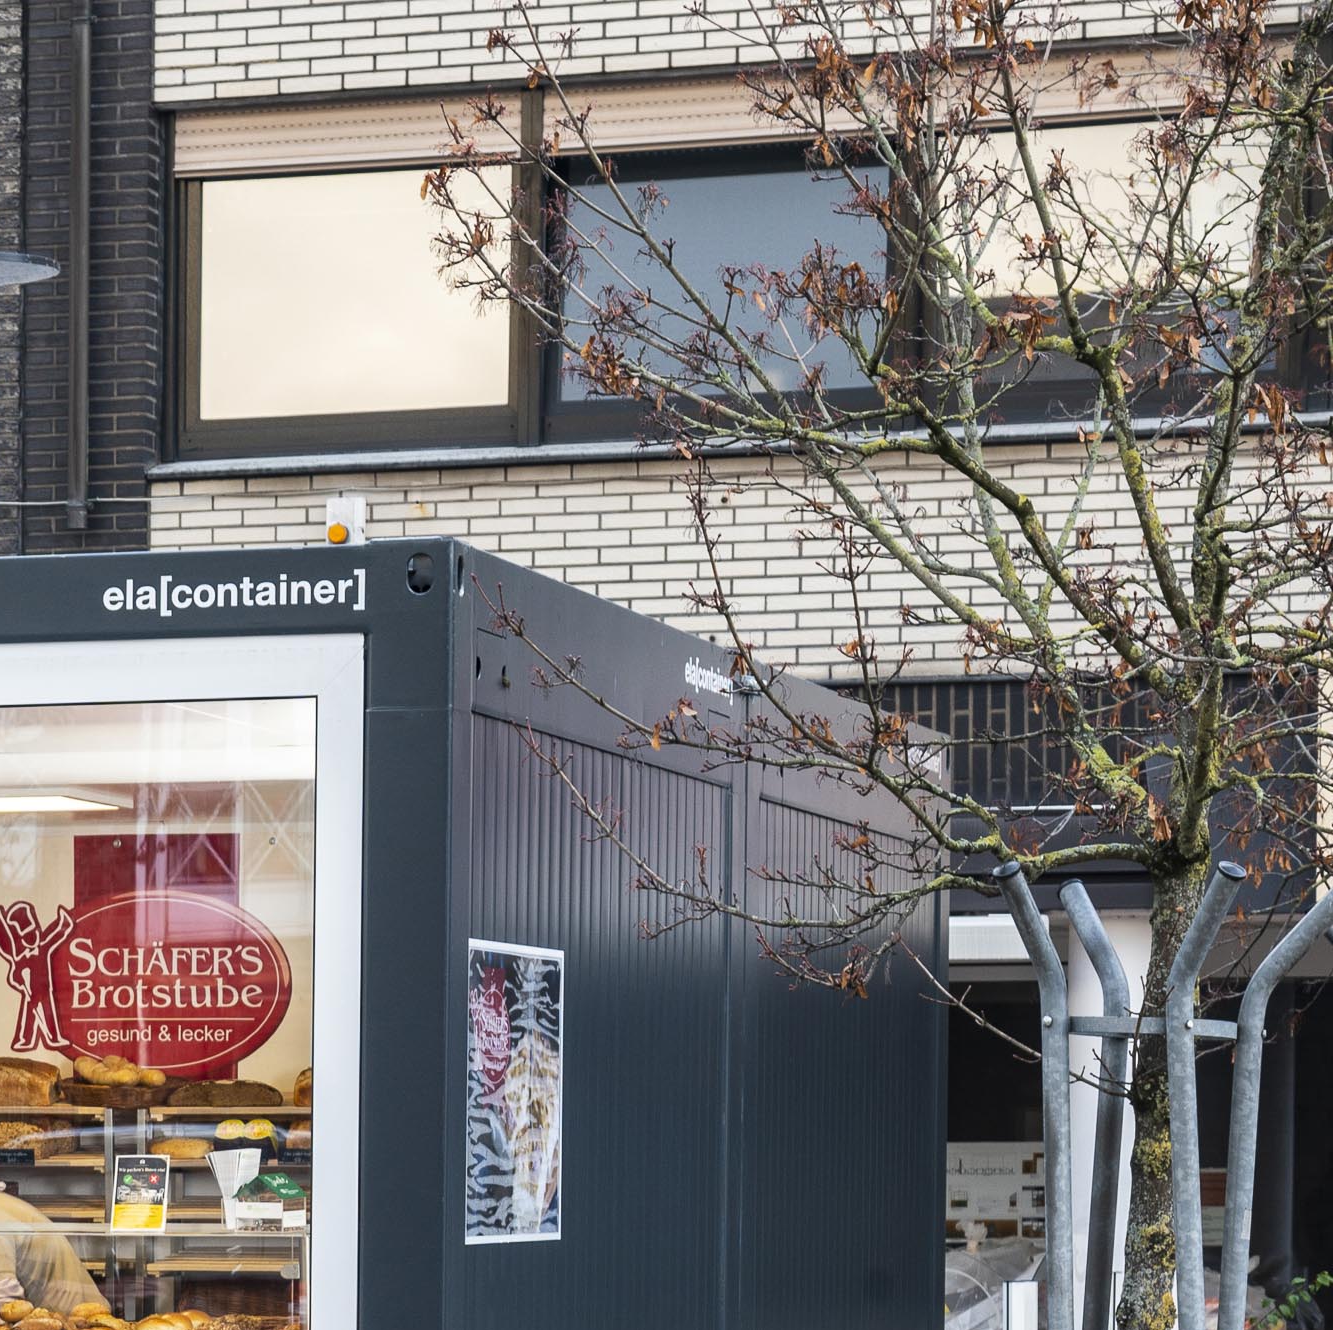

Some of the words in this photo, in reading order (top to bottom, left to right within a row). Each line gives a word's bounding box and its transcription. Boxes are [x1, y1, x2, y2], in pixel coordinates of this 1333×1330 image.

[102, 568, 366, 617] ela[container]
[71, 977, 263, 1008] Brotstube
[86, 1025, 152, 1046] gesund
[158, 1026, 172, 1041] &
[178, 1025, 233, 1042] lecker
